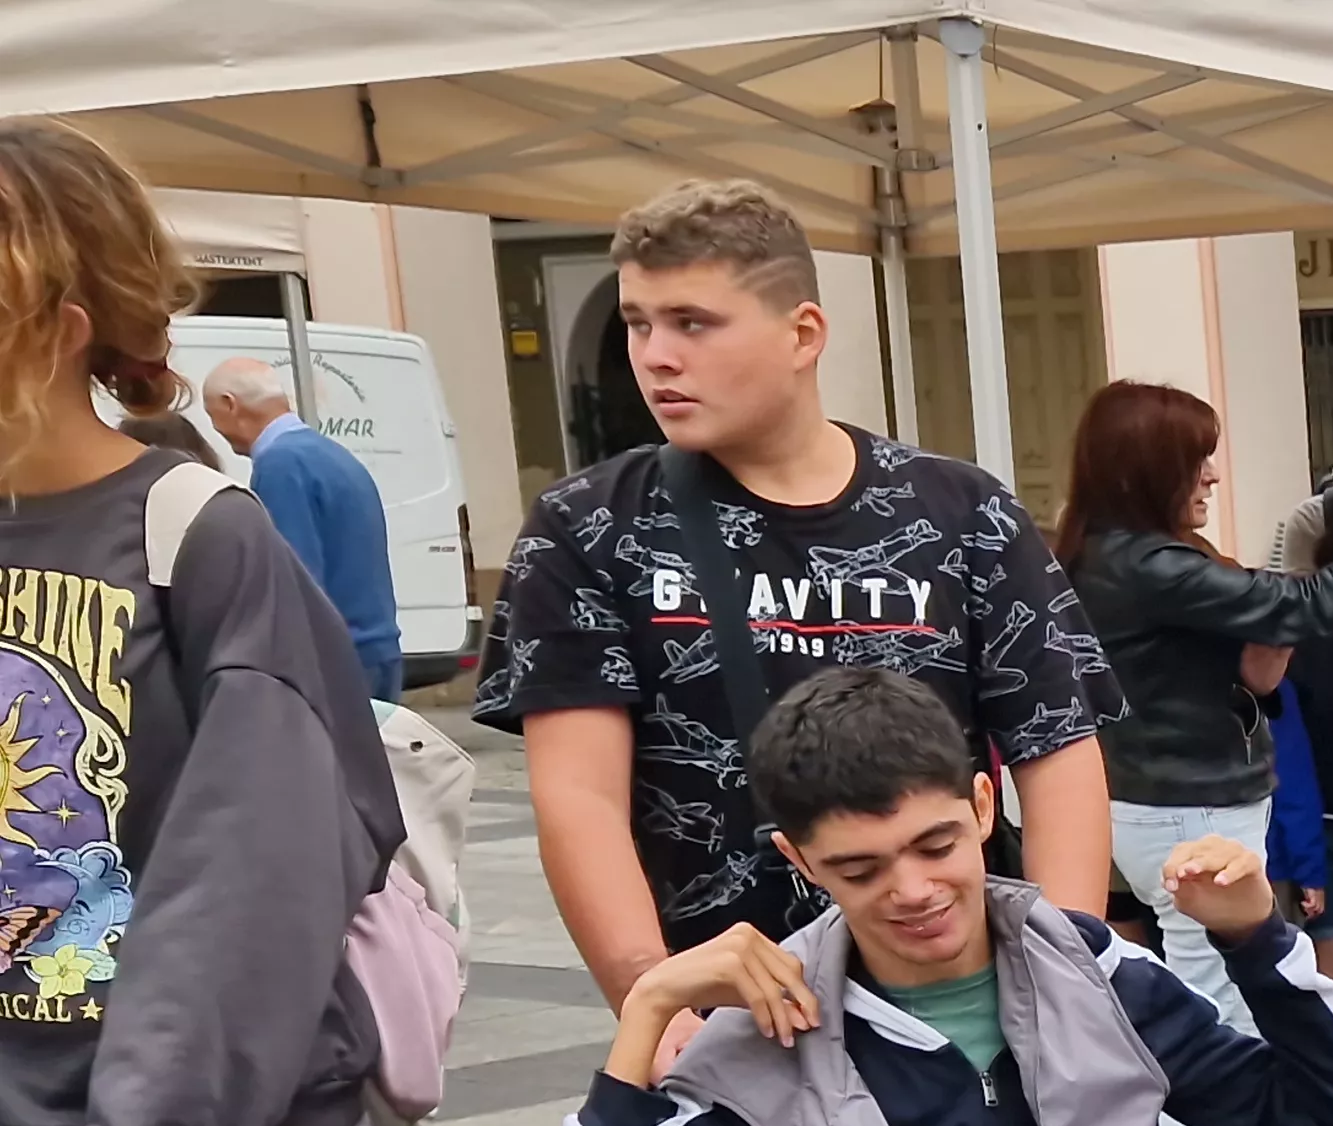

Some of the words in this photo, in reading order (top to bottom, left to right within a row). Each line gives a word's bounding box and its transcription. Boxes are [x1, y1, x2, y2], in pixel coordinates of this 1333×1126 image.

[652, 569, 931, 621] GAVITY
[0, 567, 135, 737] HINE
[769, 632, 825, 658] 1999
[0, 991, 72, 1023] ICAL
